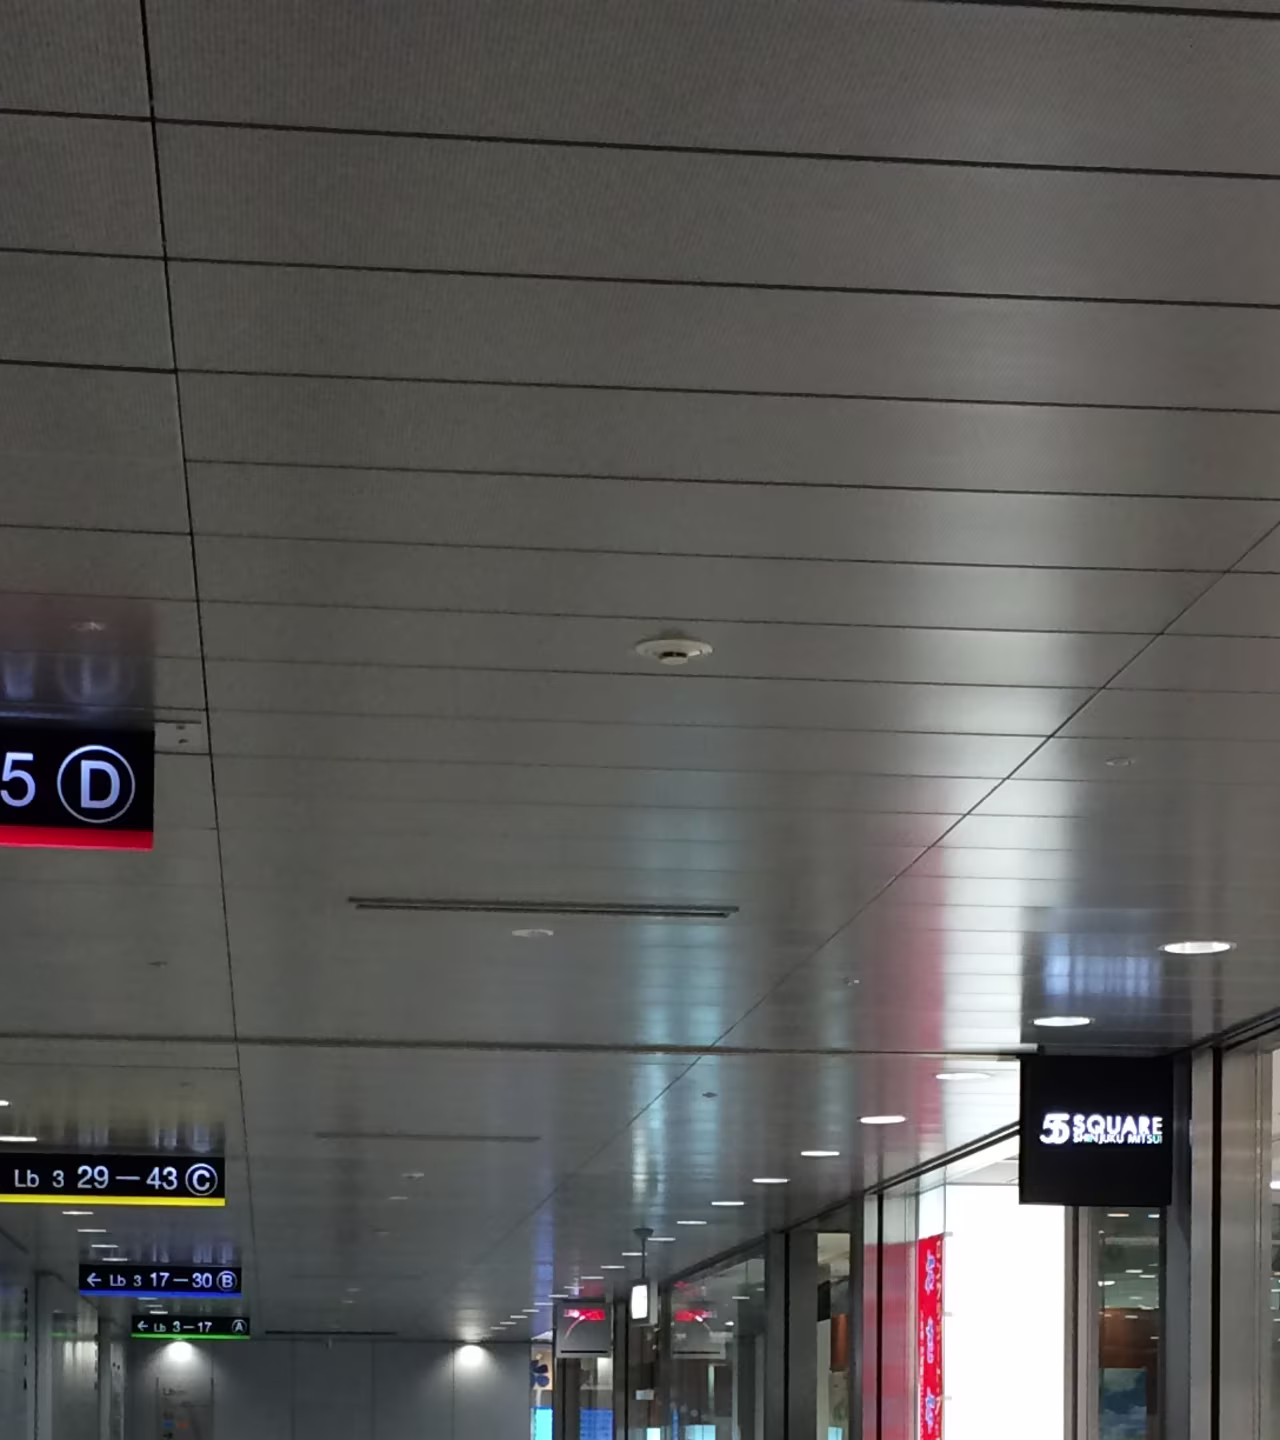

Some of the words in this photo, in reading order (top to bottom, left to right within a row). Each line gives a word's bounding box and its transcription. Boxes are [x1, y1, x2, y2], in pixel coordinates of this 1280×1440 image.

[1073, 1114, 1163, 1135] SQUARE
[14, 1169, 40, 1188] Lb
[52, 1170, 65, 1188] 3
[110, 1274, 126, 1287] Lb
[133, 1275, 142, 1287] 3
